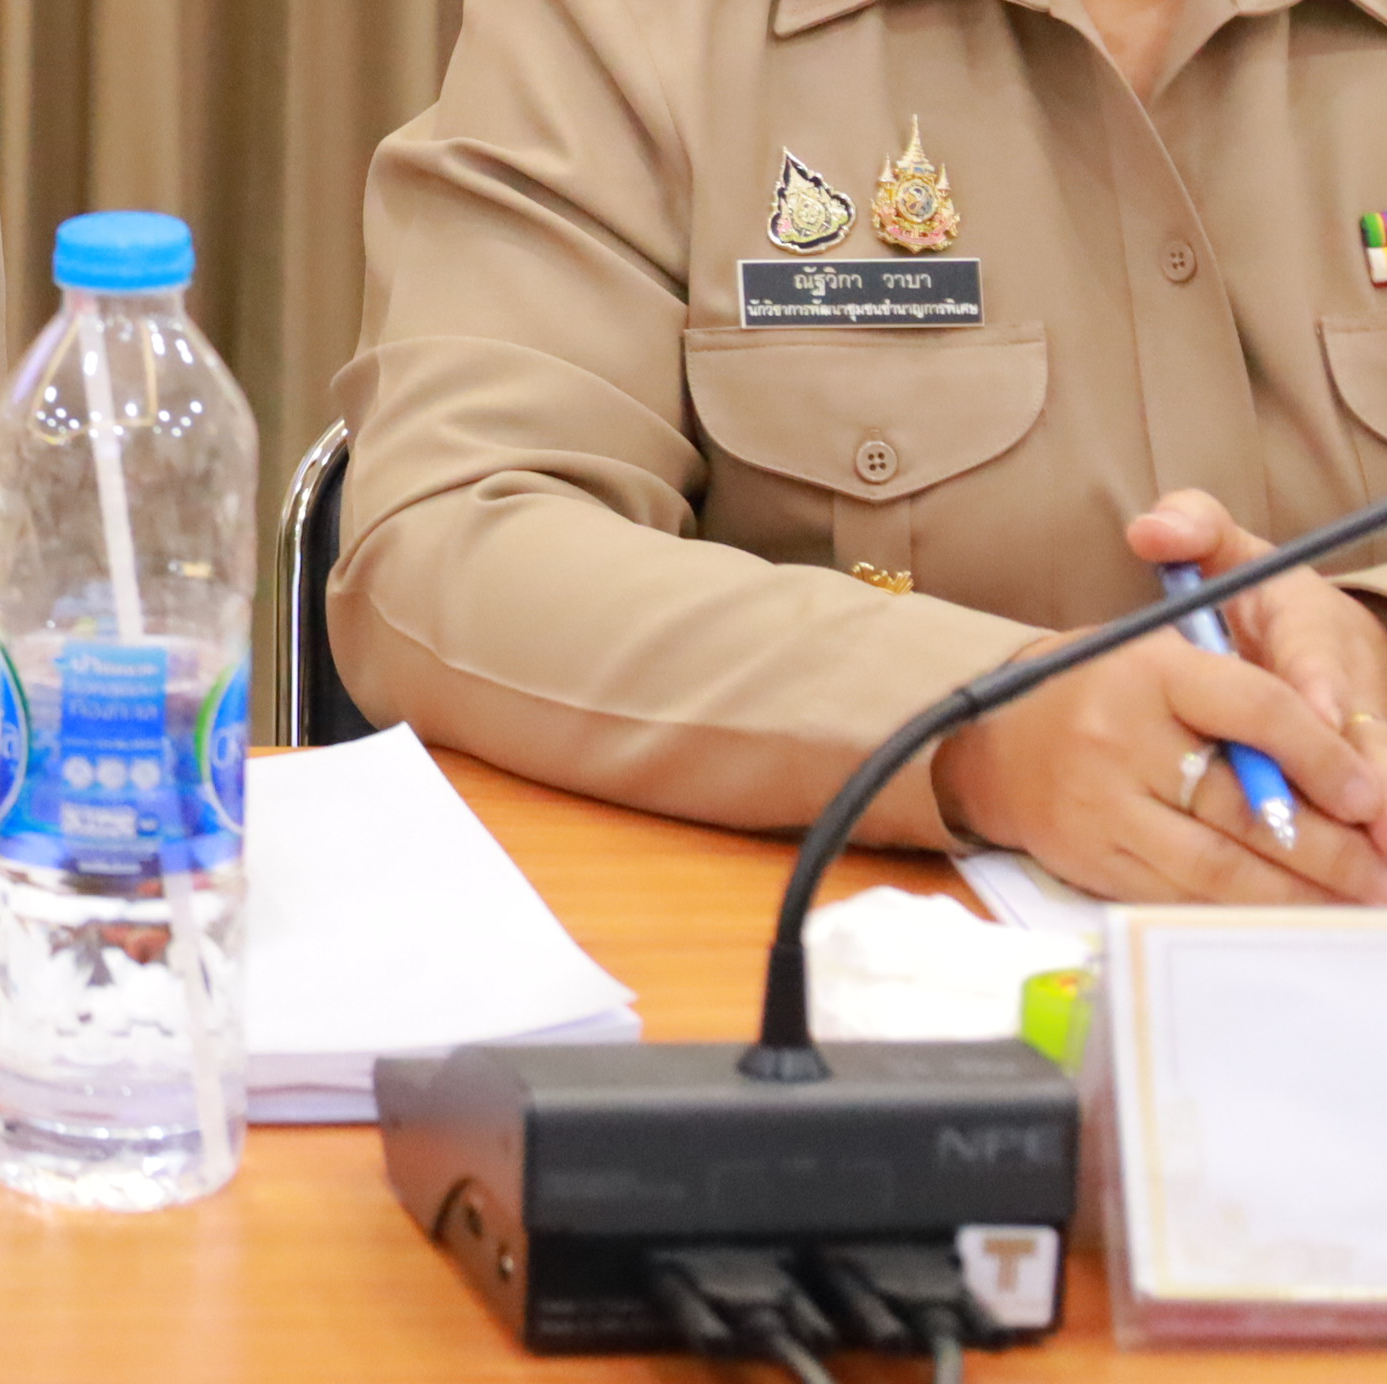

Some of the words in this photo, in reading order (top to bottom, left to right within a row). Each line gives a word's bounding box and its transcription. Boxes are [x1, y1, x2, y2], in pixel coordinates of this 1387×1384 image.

[793, 266, 863, 297] ณัฐวิกา
[882, 273, 932, 289] วาบา
